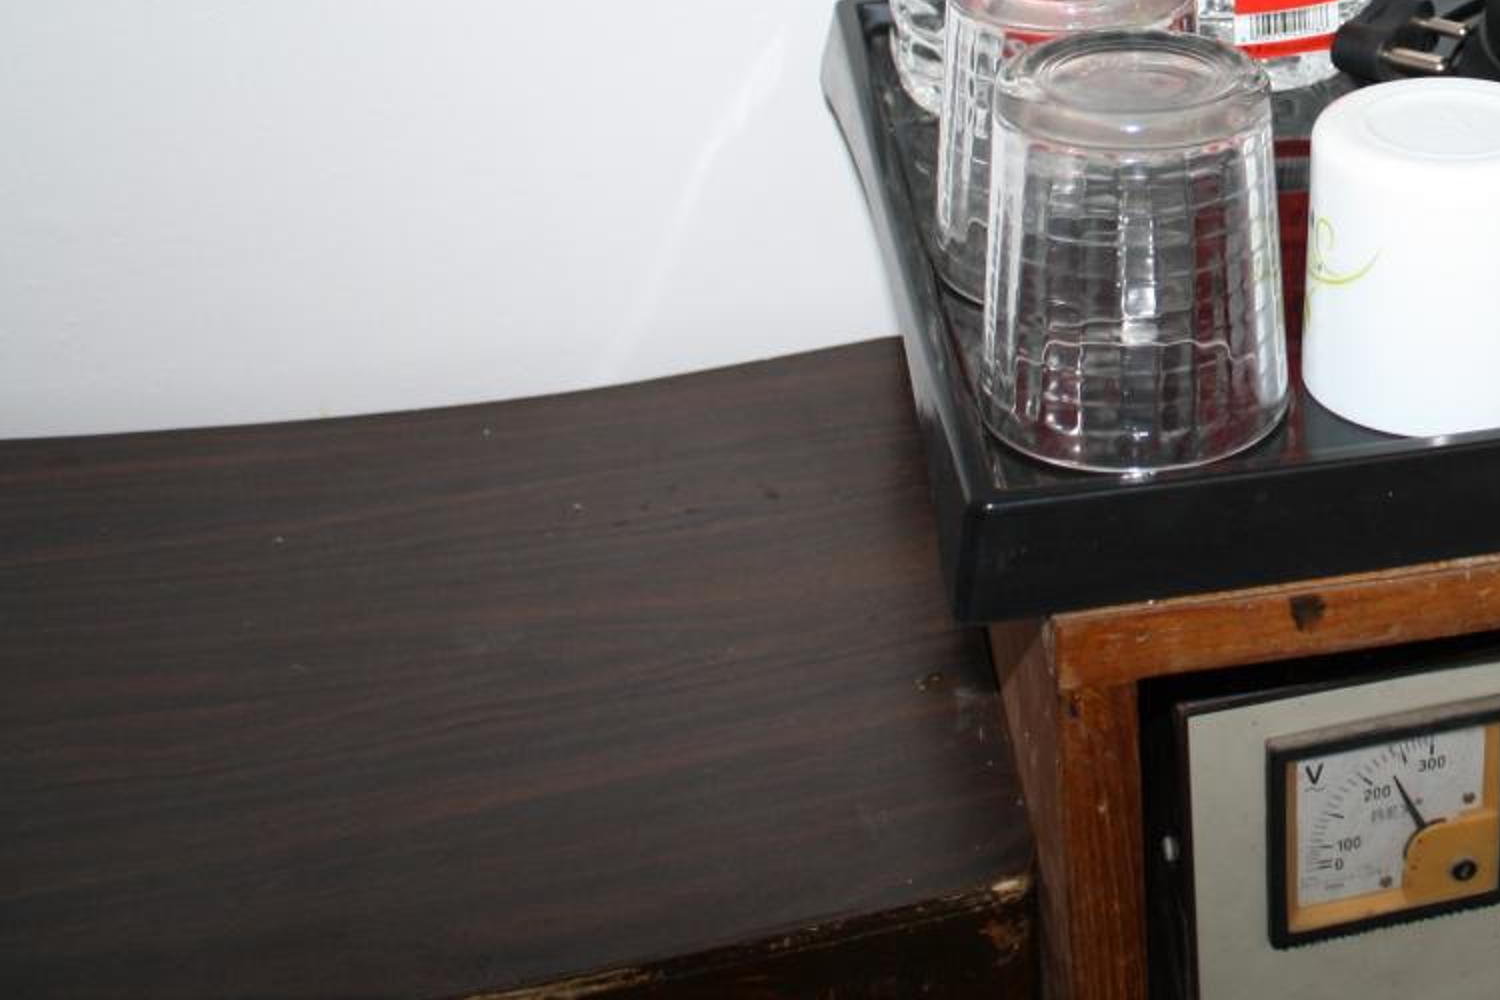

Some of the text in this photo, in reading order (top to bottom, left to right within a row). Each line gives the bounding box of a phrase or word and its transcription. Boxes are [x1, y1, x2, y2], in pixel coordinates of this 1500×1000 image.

[1417, 755, 1446, 773] 300
[1305, 763, 1325, 785] V
[1363, 784, 1391, 803] 200
[1335, 835, 1362, 852] 100
[1334, 859, 1344, 872] 0
